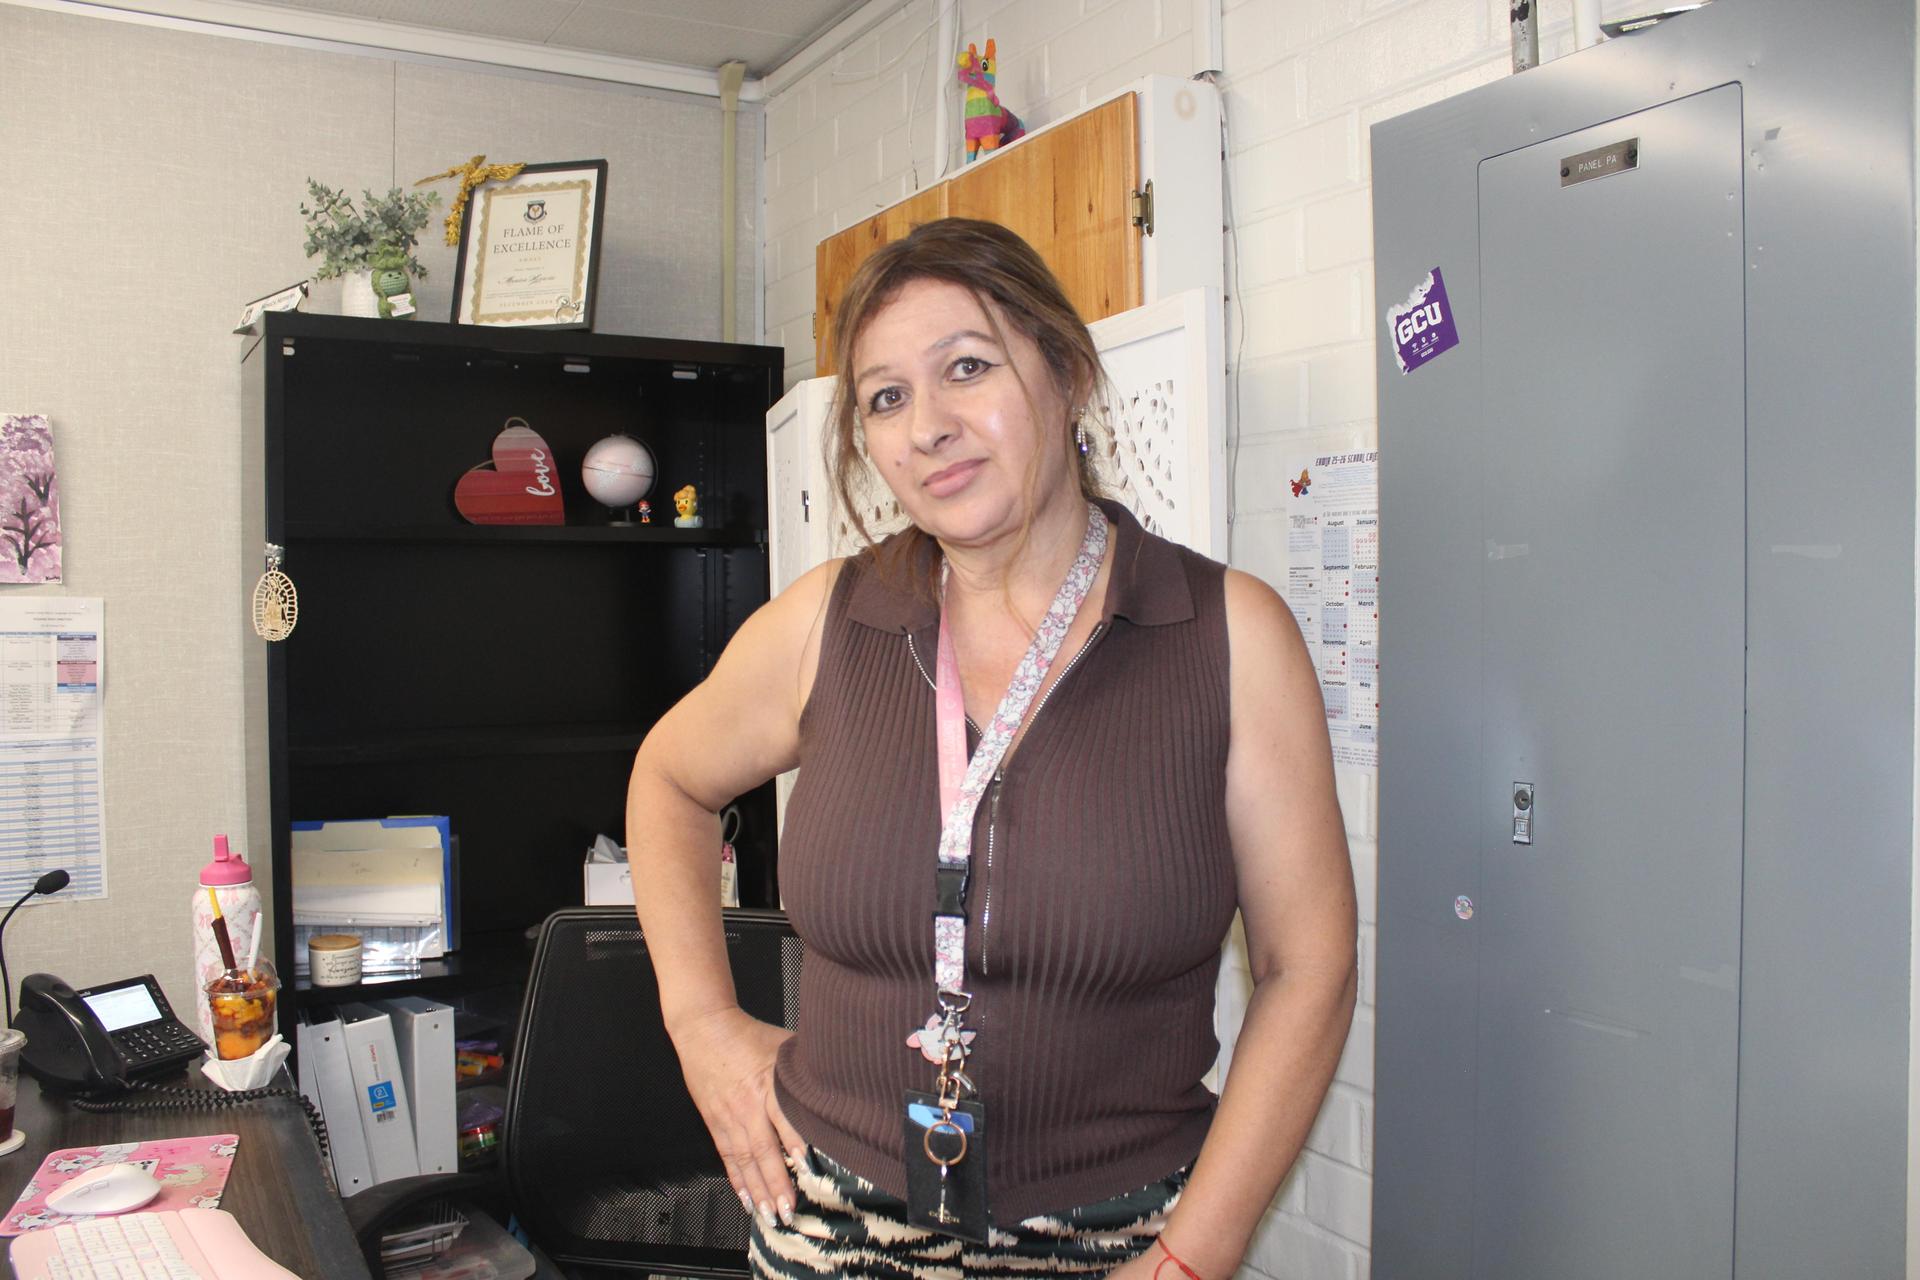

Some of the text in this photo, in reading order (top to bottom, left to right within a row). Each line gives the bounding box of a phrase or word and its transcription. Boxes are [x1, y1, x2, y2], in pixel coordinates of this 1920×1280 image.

[1578, 154, 1617, 173] PANEL PA
[503, 224, 565, 238] FLAME OF
[493, 239, 571, 254] EXCELLENCE
[1397, 301, 1443, 345] GCU
[1347, 453, 1365, 463] SCHOOL
